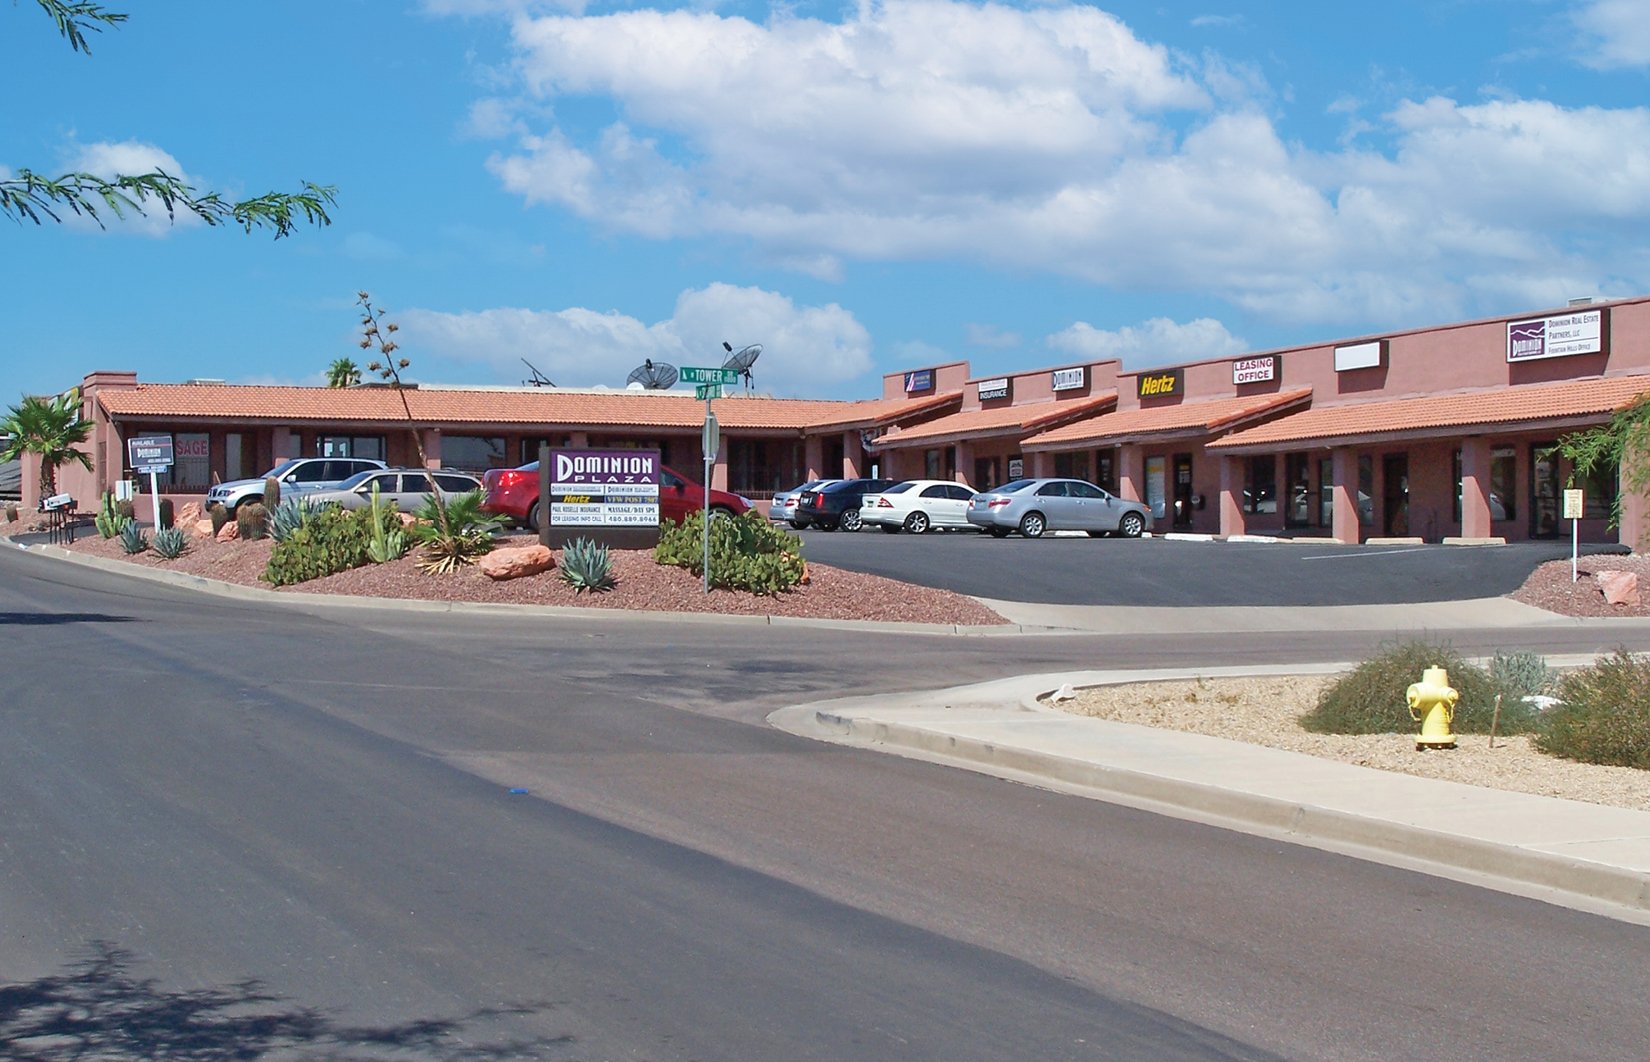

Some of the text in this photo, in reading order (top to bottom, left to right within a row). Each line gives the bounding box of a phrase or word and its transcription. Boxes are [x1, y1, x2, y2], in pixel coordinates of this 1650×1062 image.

[1549, 315, 1599, 328] DOMINION REAL ESTATE
[1234, 359, 1272, 371] LEASING
[695, 369, 722, 382] TOWER
[1237, 370, 1269, 381] OFFICE
[1141, 375, 1175, 395] Hertz
[980, 389, 1007, 399] INSURANCE
[176, 441, 208, 455] SAGE
[557, 454, 653, 482] DOMINION
[574, 475, 652, 483] PLAZA
[563, 495, 591, 503] Hertz
